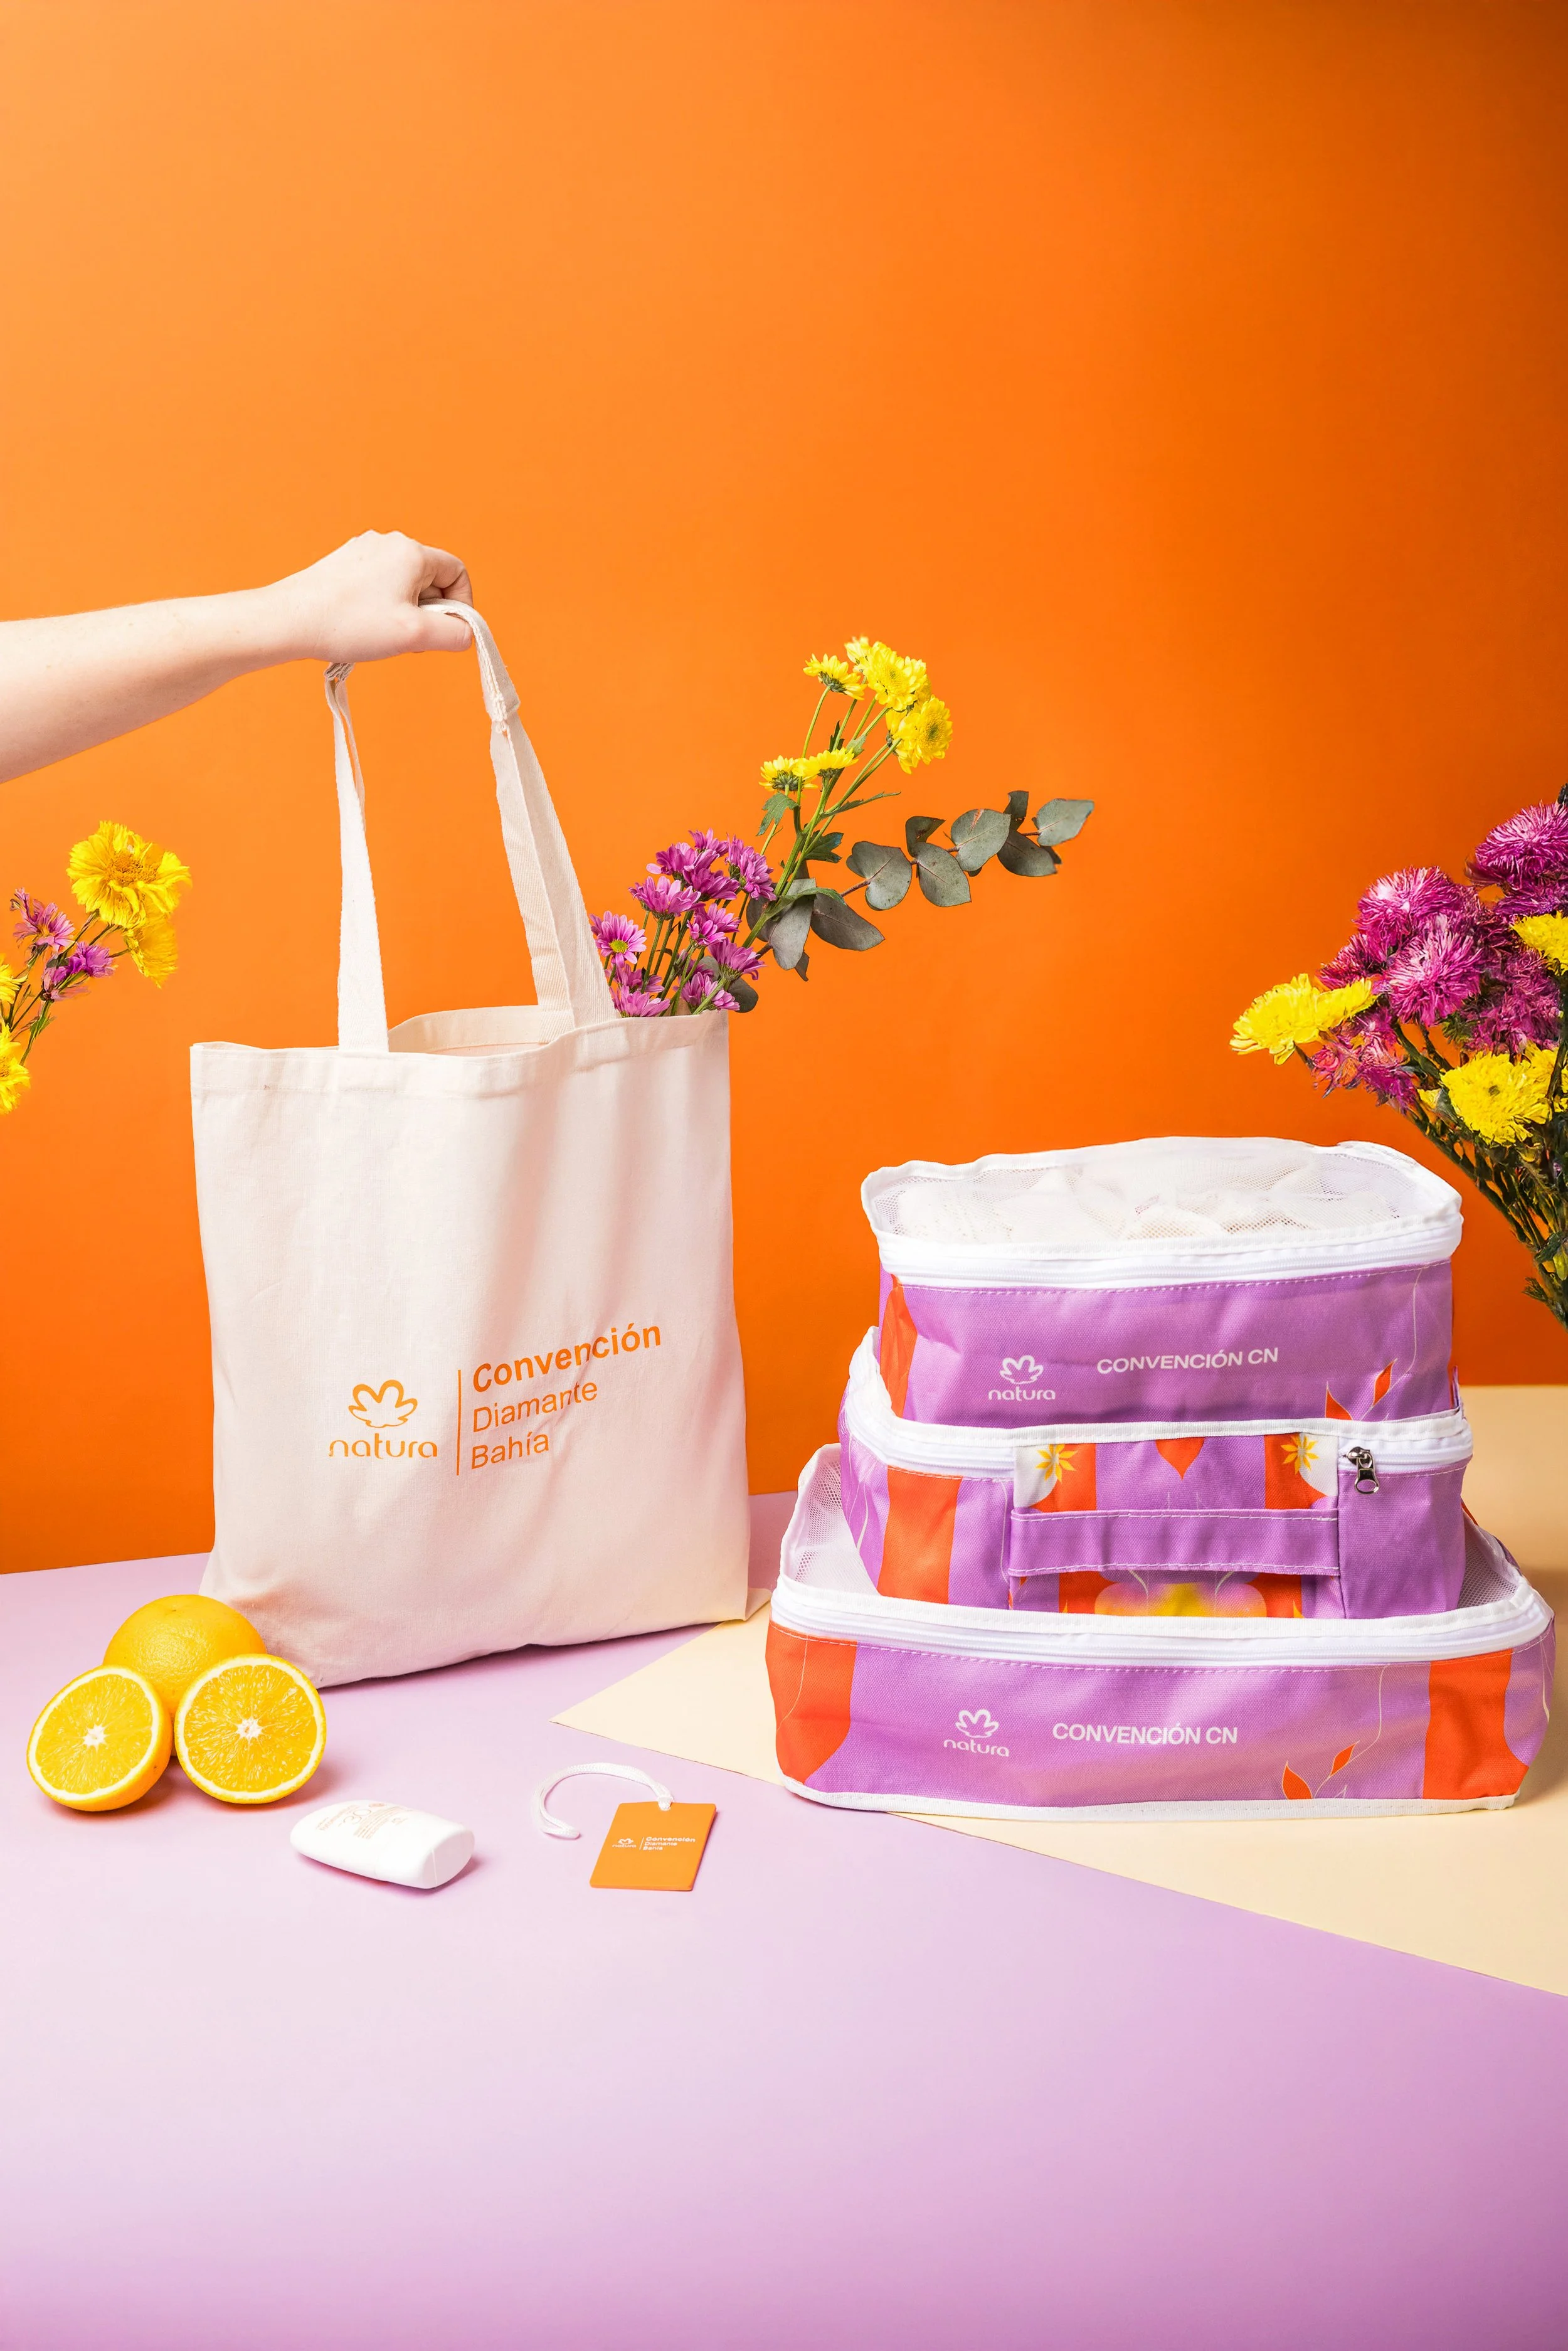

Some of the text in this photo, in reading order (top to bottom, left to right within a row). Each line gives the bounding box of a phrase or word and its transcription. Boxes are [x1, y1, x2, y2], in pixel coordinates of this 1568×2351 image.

[473, 1323, 661, 1393] Convención
[1096, 1347, 1279, 1374] CONVENCIÓN CN
[474, 1381, 598, 1433] Diamante
[988, 1386, 1056, 1402] natura
[328, 1433, 438, 1459] natura
[471, 1431, 549, 1470] Bahía
[1052, 1722, 1238, 1745] CONVENCIÓN CN
[943, 1738, 1010, 1758] natura
